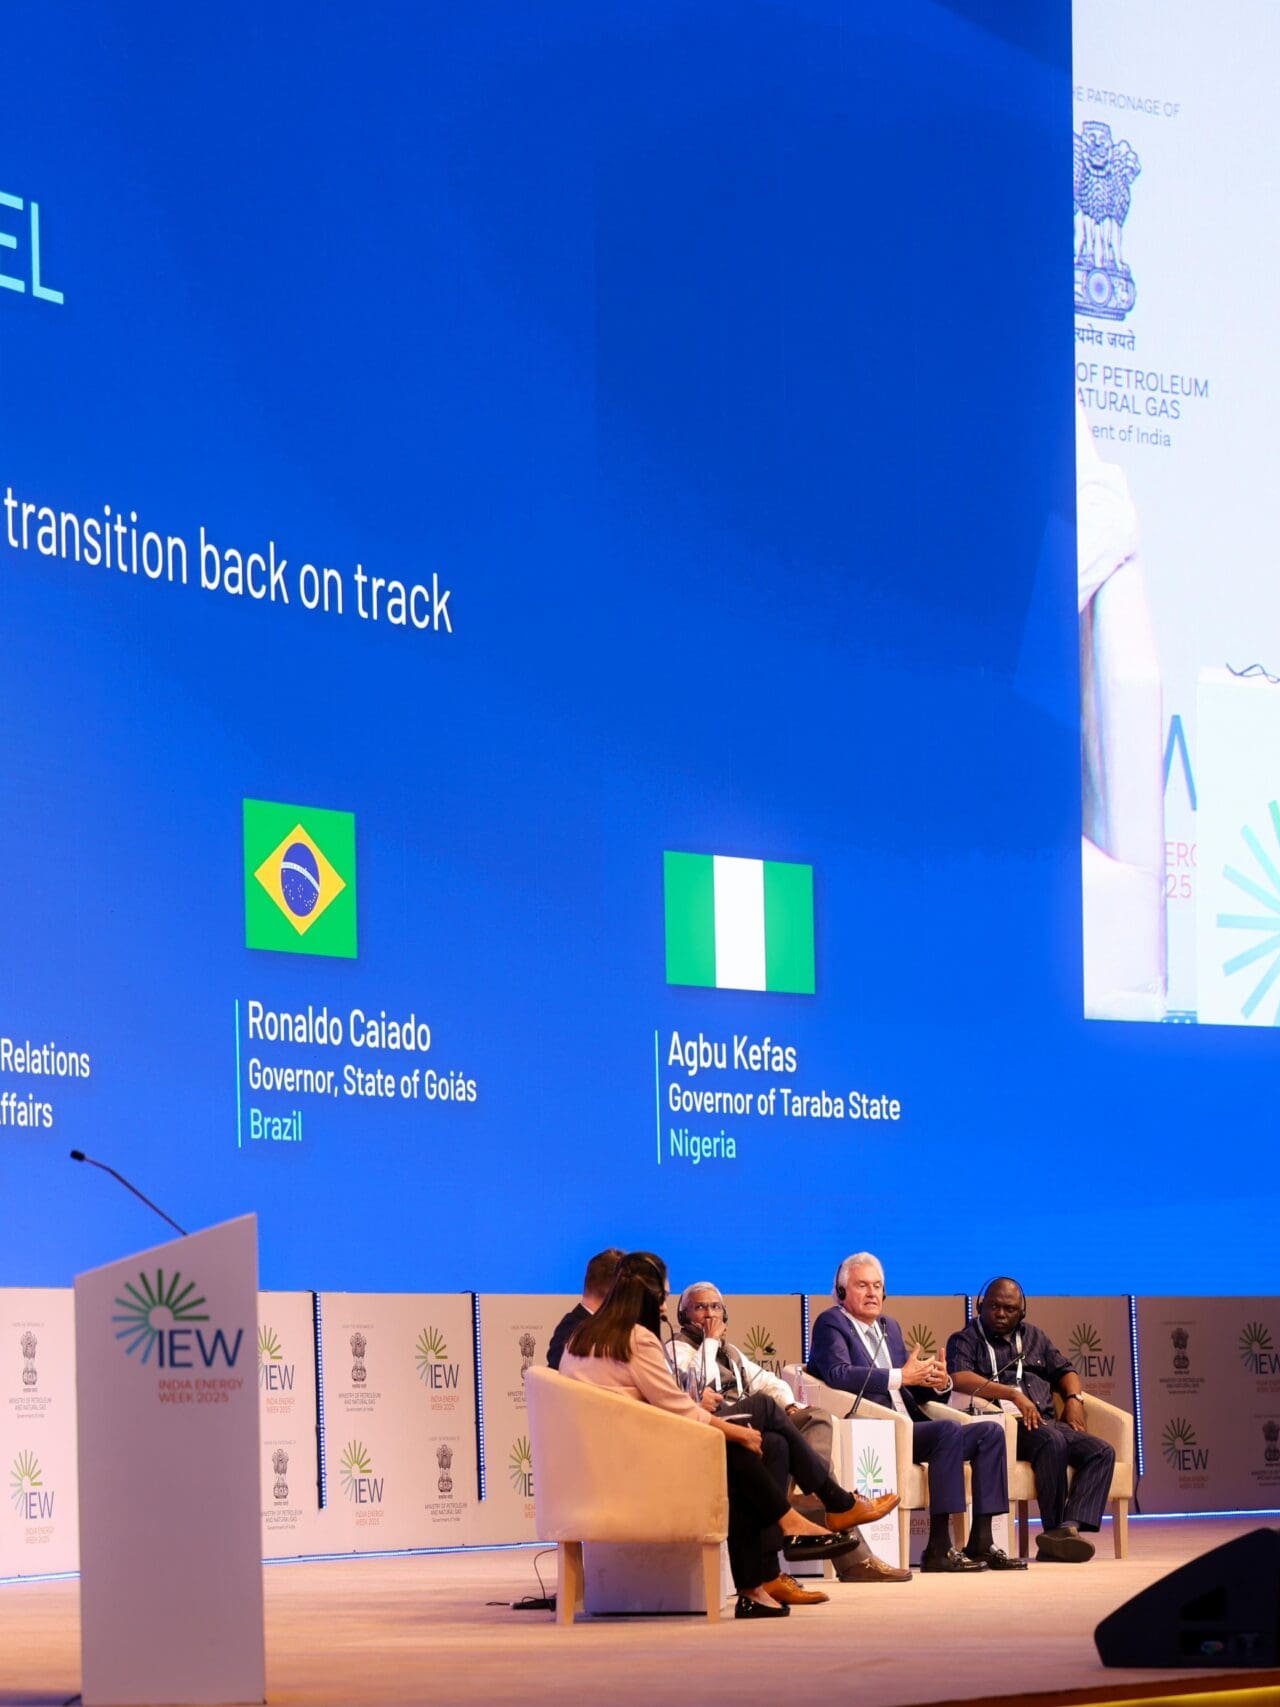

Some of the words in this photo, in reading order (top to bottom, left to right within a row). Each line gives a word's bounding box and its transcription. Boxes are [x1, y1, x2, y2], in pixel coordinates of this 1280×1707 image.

[1087, 88, 1160, 116] PATRONAGE
[1163, 102, 1181, 118] OF
[1076, 362, 1098, 384] OF
[1103, 365, 1209, 399] PETROLEUM
[1145, 396, 1181, 420] GAS
[1118, 425, 1133, 442] of
[1136, 427, 1171, 446] India
[4, 487, 187, 585] transition
[200, 527, 290, 604] back
[299, 564, 343, 614] on
[355, 564, 454, 633] track
[248, 1000, 343, 1046] Ronaldo
[349, 1009, 431, 1052] Caiado
[0, 1038, 90, 1078] Relations
[668, 1031, 727, 1077] Agbu
[733, 1034, 798, 1073] Kefas
[248, 1058, 338, 1098] Governor,
[343, 1064, 395, 1099] State
[400, 1069, 421, 1099] of
[424, 1069, 477, 1103] Goiás
[0, 1092, 53, 1128] ffairs
[668, 1083, 753, 1115] Governor
[757, 1088, 776, 1116] of
[780, 1088, 844, 1118] Taraba
[848, 1091, 901, 1121] State
[250, 1108, 302, 1141] Brazil
[670, 1128, 736, 1165] Nigeria
[158, 1328, 244, 1368] IEW
[265, 1364, 294, 1390] IEW
[430, 1364, 459, 1389] IEW
[1084, 1355, 1115, 1377] IEW
[159, 1379, 192, 1390] INDIA
[195, 1378, 243, 1390] ENERGY
[1178, 1449, 1209, 1470] IEW
[25, 1491, 54, 1519] IEW
[355, 1478, 384, 1503] IEW
